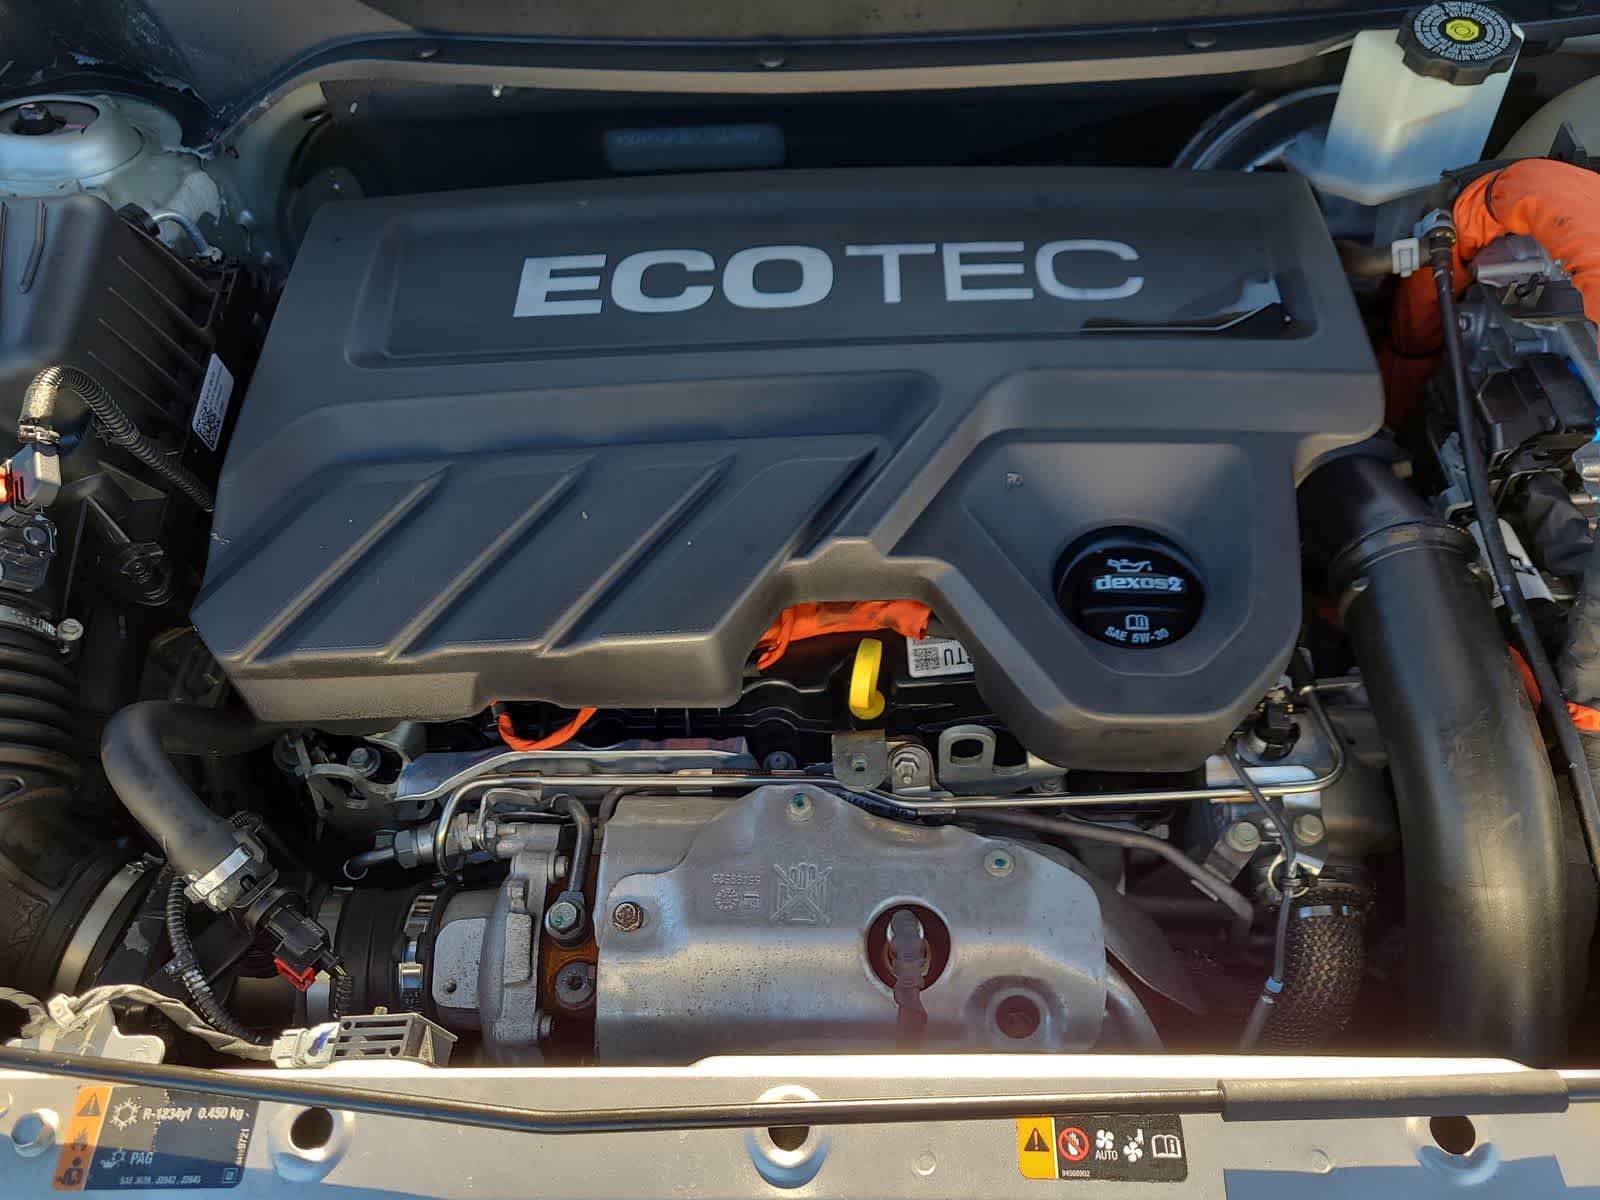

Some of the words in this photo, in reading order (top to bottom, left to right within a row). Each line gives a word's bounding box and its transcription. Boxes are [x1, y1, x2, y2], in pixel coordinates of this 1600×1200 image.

[512, 239, 1145, 317] ECOTEC
[1095, 575, 1182, 592] dexos2
[1105, 626, 1128, 641] SAE
[1131, 628, 1169, 643] 5W-30
[143, 1107, 193, 1122] R-1234yf
[230, 1107, 245, 1121] kg
[130, 1152, 154, 1165] PAG
[1094, 1150, 1118, 1161] AUTO
